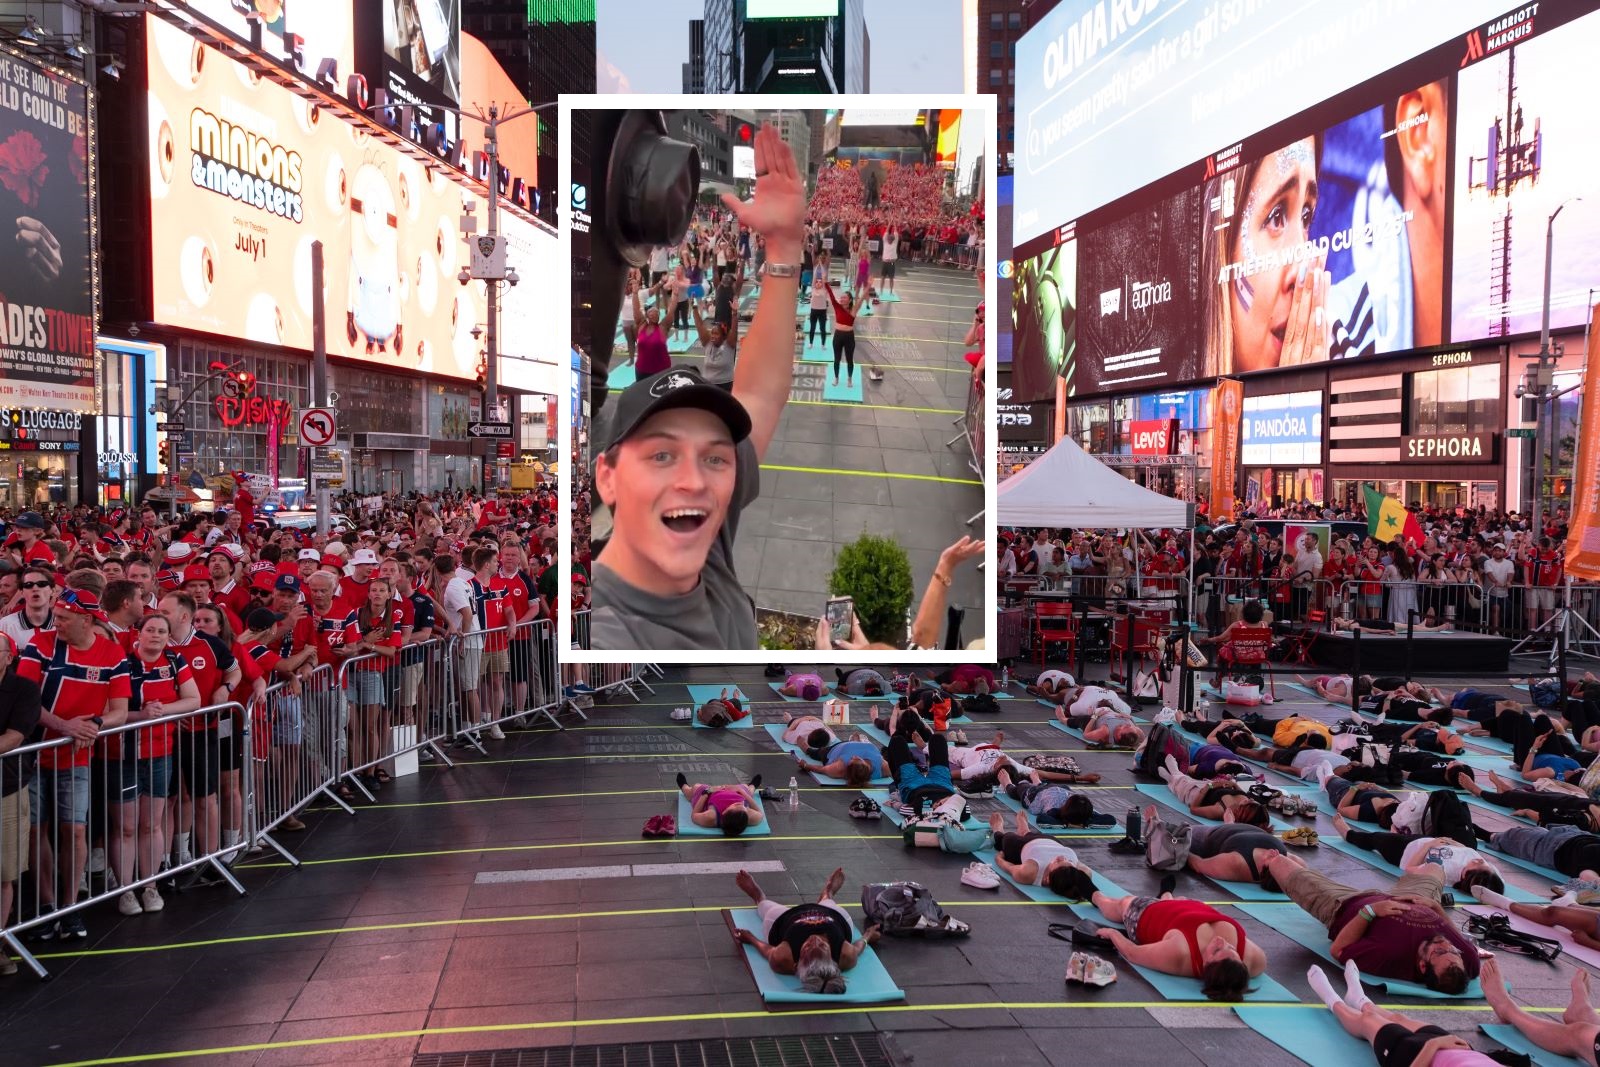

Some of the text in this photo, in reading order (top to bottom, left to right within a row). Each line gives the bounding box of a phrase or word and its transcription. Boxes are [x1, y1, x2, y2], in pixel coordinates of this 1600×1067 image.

[1487, 21, 1532, 51] MARQUIS
[1488, 3, 1539, 37] MARRIOTT
[1043, 2, 1107, 89] OLIVIA
[1092, 72, 1130, 125] pretty
[1130, 46, 1156, 90] sad
[1156, 36, 1180, 73] for
[1193, 1, 1219, 59] girl
[0, 59, 68, 105] ME SEE HOW THE
[0, 82, 19, 111] LD
[23, 91, 65, 130] COULD
[190, 106, 302, 193] minions
[235, 231, 266, 263] July 1
[1280, 235, 1329, 266] WORLD
[1332, 228, 1362, 252] CU
[1132, 277, 1171, 316] euphoria
[0, 302, 92, 356] ADESTOWN
[0, 348, 94, 369] WAY'S GLOBAL SENSATION
[1432, 351, 1472, 366] SEPHORA
[0, 410, 82, 430] S LUGGAGE
[26, 428, 40, 439] NY
[215, 394, 292, 447] Disney
[494, 425, 508, 433] WAY
[97, 452, 138, 463] POLO ASSN.
[1408, 437, 1482, 457] SEPHORA
